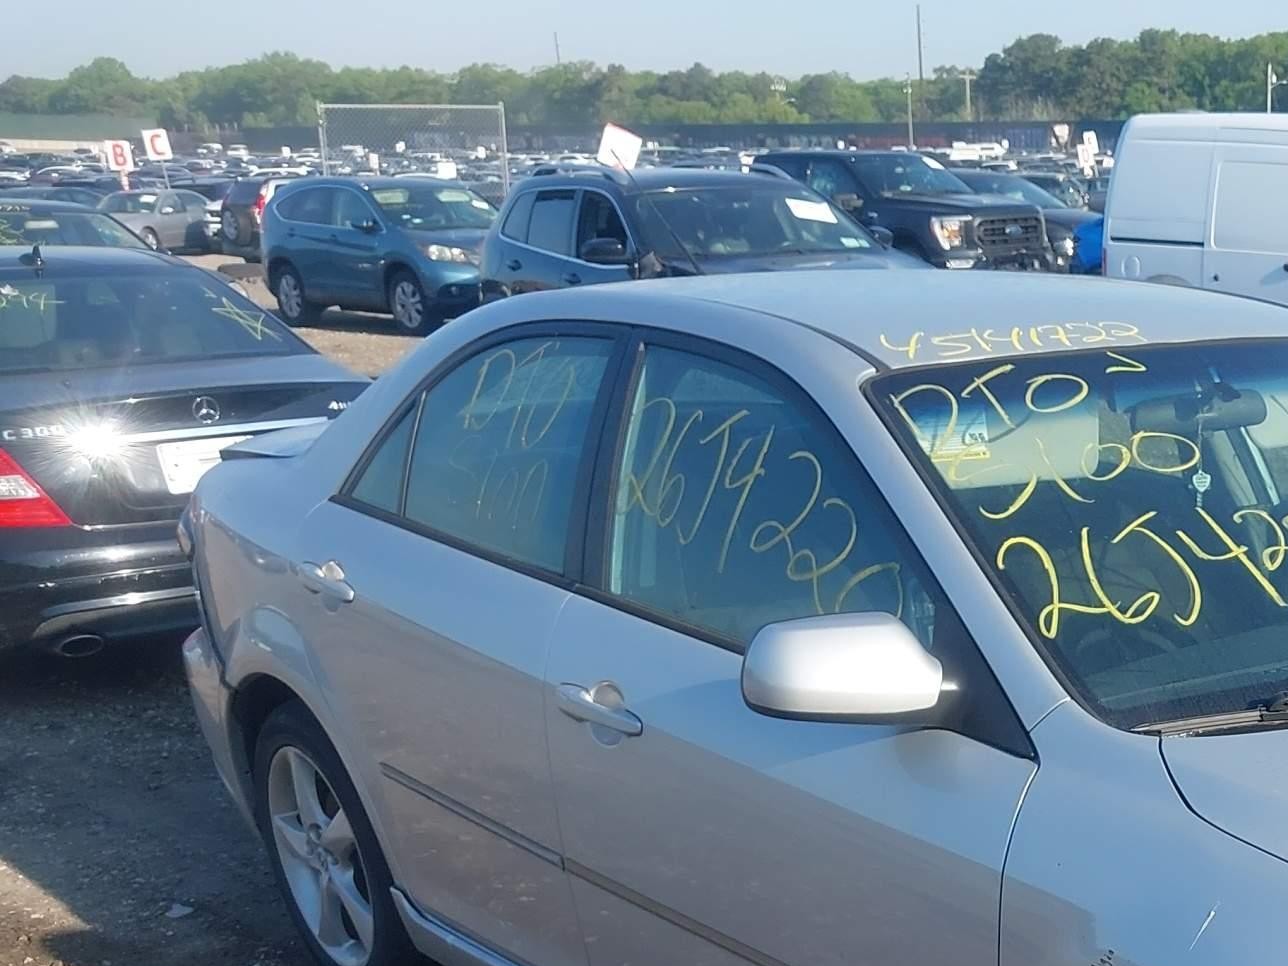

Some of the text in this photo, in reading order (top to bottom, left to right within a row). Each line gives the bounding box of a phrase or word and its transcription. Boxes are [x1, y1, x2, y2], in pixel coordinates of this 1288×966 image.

[112, 143, 128, 167] B
[149, 133, 166, 156] C
[878, 320, 1149, 360] 45141722
[889, 363, 1090, 458] DTO
[2, 429, 17, 440] C
